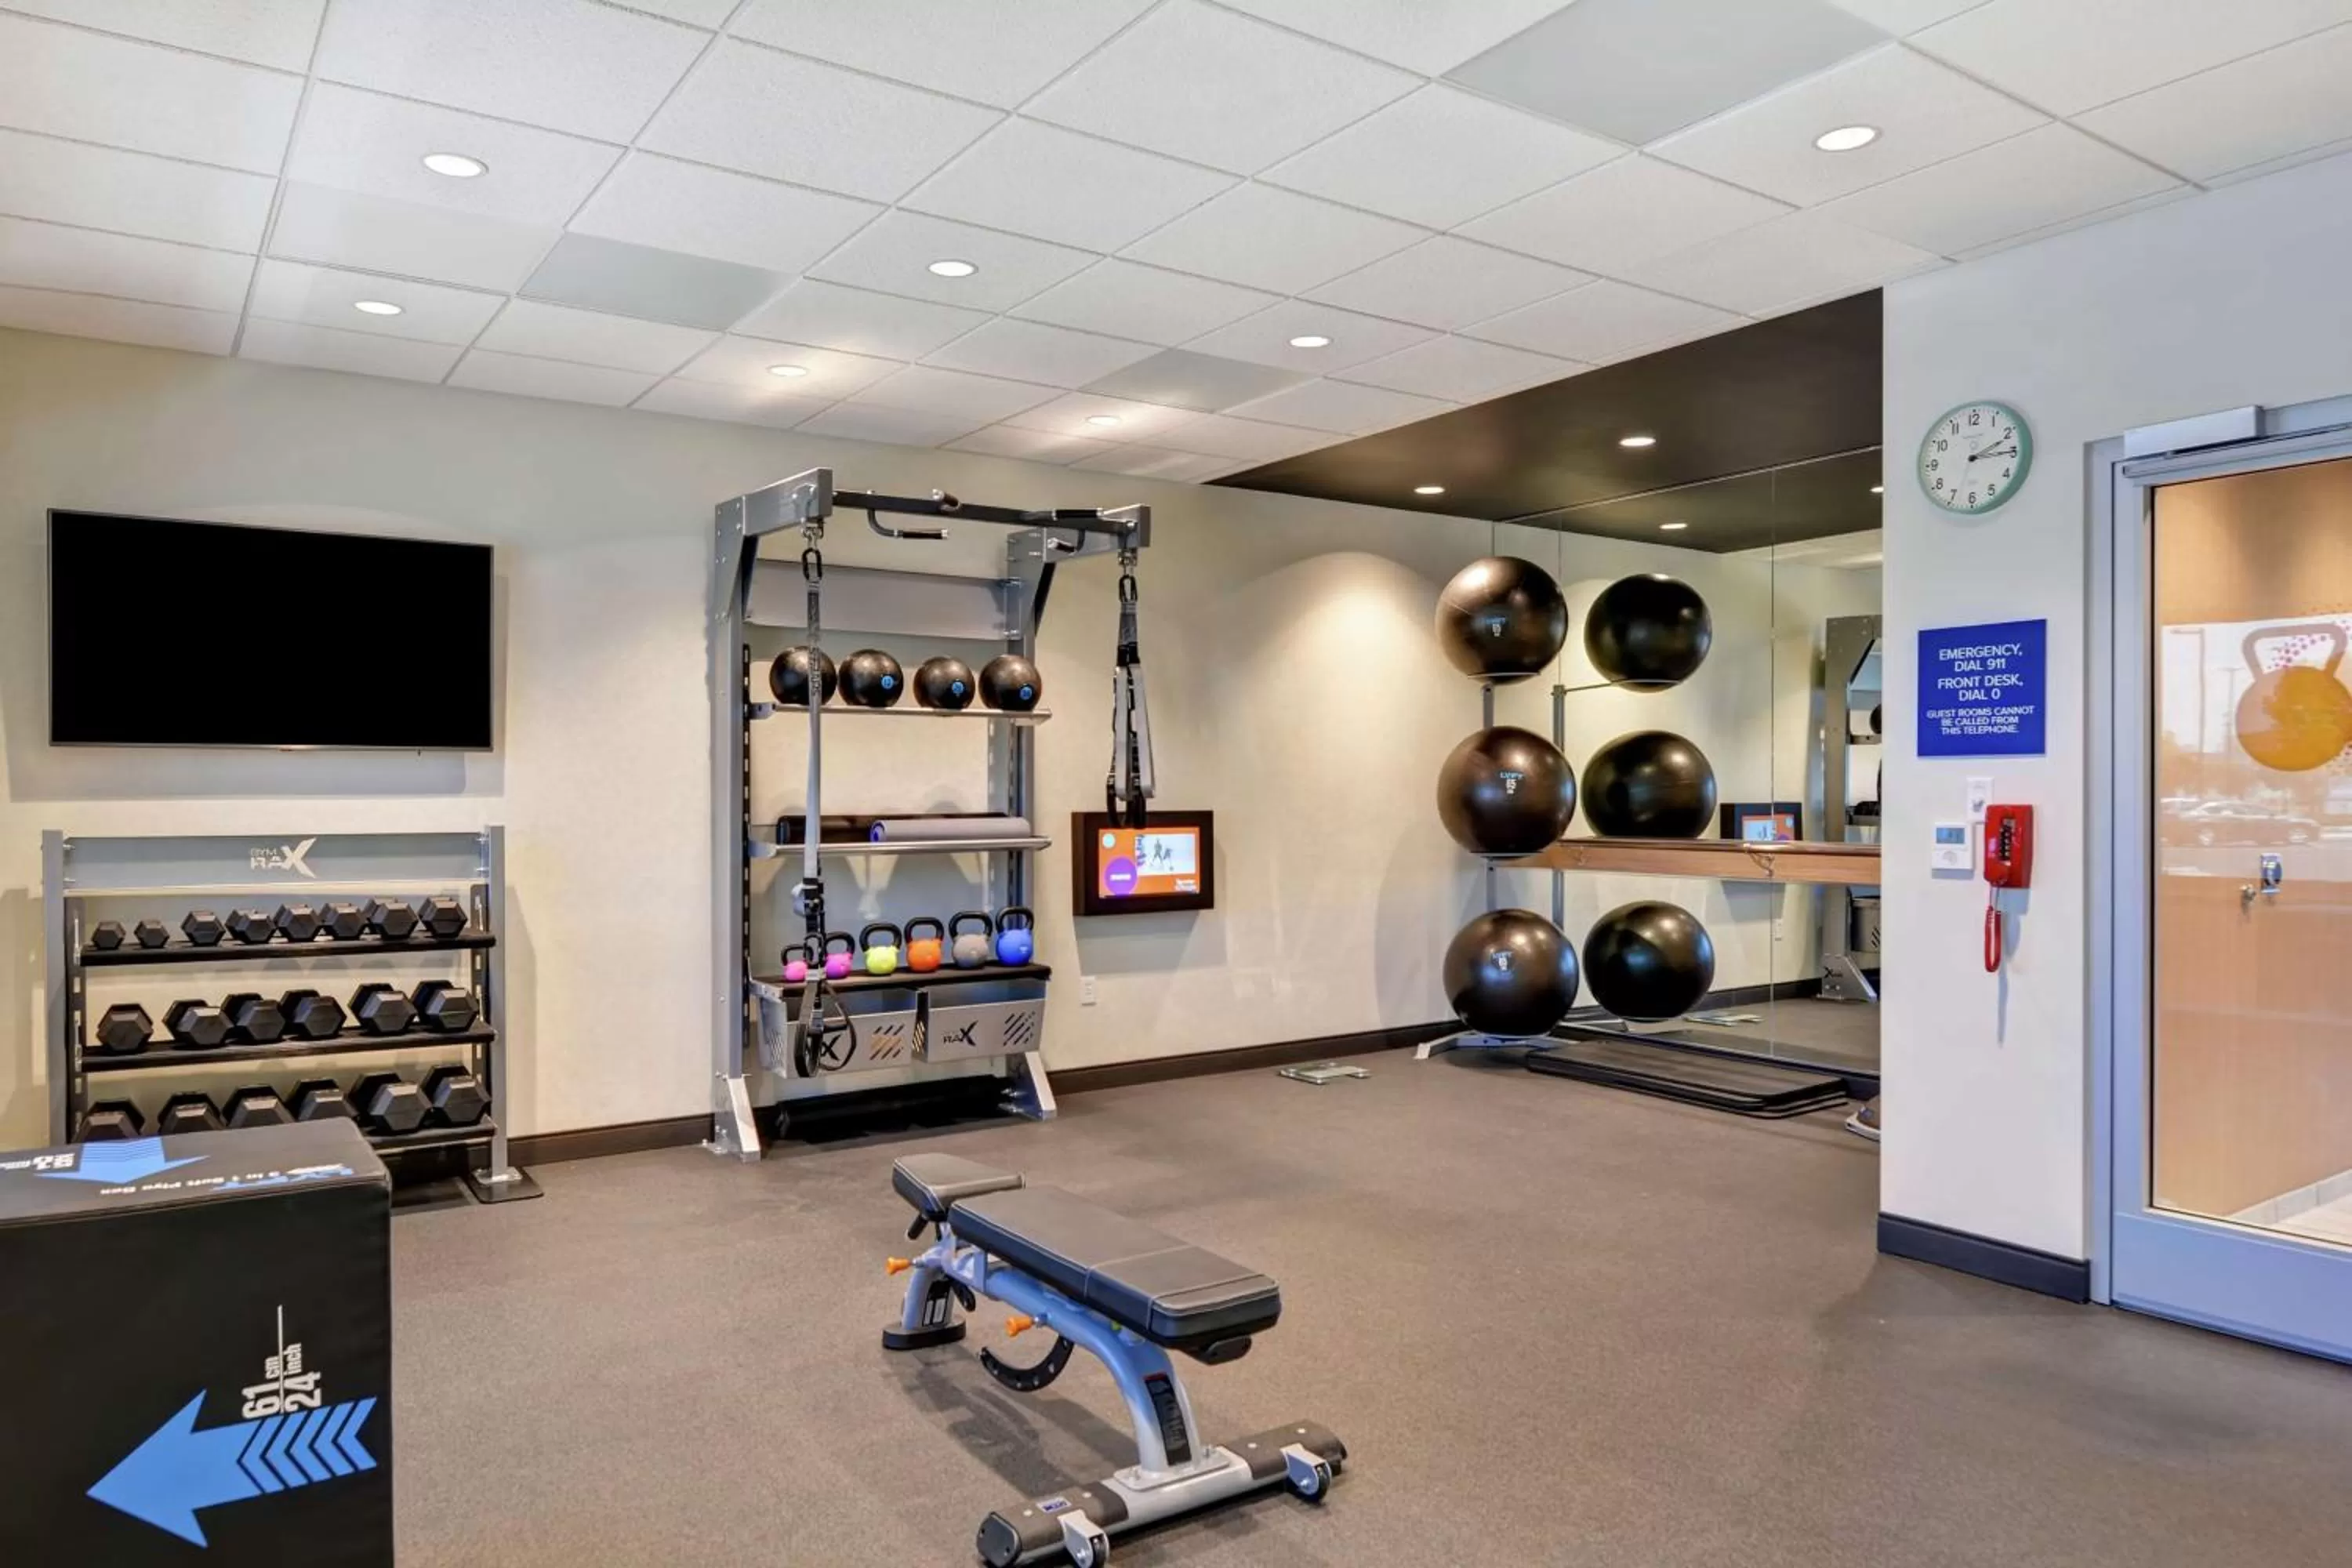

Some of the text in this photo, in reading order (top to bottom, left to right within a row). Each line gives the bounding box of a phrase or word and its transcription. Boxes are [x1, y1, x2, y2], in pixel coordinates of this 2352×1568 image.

[1969, 413, 1980, 426] 12
[1951, 422, 1959, 436] 11
[2003, 426, 2012, 440] 2
[1937, 439, 1948, 452] 10
[1930, 459, 1939, 471] 9
[2002, 467, 2010, 478] 4
[1936, 477, 1944, 490] 8
[1987, 484, 1995, 496] 5
[1951, 488, 1958, 501] 7
[1969, 492, 1976, 504] 6
[1955, 659, 2006, 672] DIAL 911
[1937, 676, 1981, 689] FRONT
[1958, 690, 1987, 701] DIAL
[1926, 706, 2035, 718] GUEST ROOMS CANNOT
[1955, 717, 1990, 725] CALLED
[1991, 716, 2019, 724] FROM
[283, 1342, 322, 1412] 24 inch
[241, 1356, 281, 1419] 61 cm
